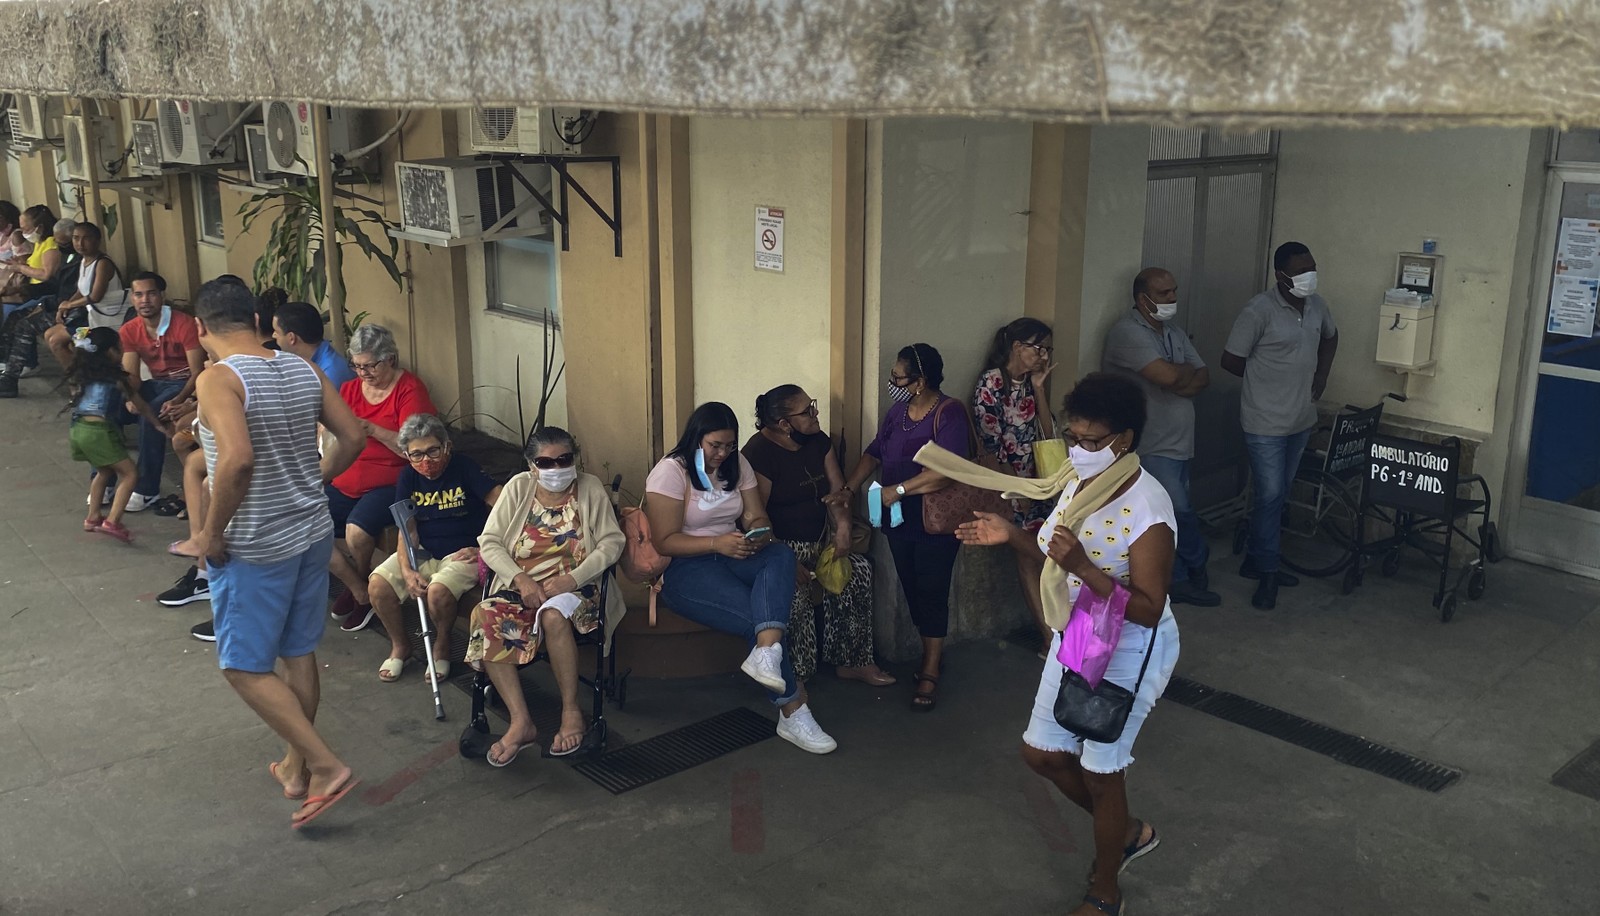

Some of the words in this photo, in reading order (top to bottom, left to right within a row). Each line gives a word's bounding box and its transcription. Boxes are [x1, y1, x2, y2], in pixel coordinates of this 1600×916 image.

[300, 125, 309, 136] LG
[1371, 443, 1449, 472] AMBULATÓRIO
[1371, 463, 1390, 482] P6
[1398, 469, 1413, 487] 1º
[1414, 473, 1445, 495] AND.
[438, 500, 465, 511] BRASIL
